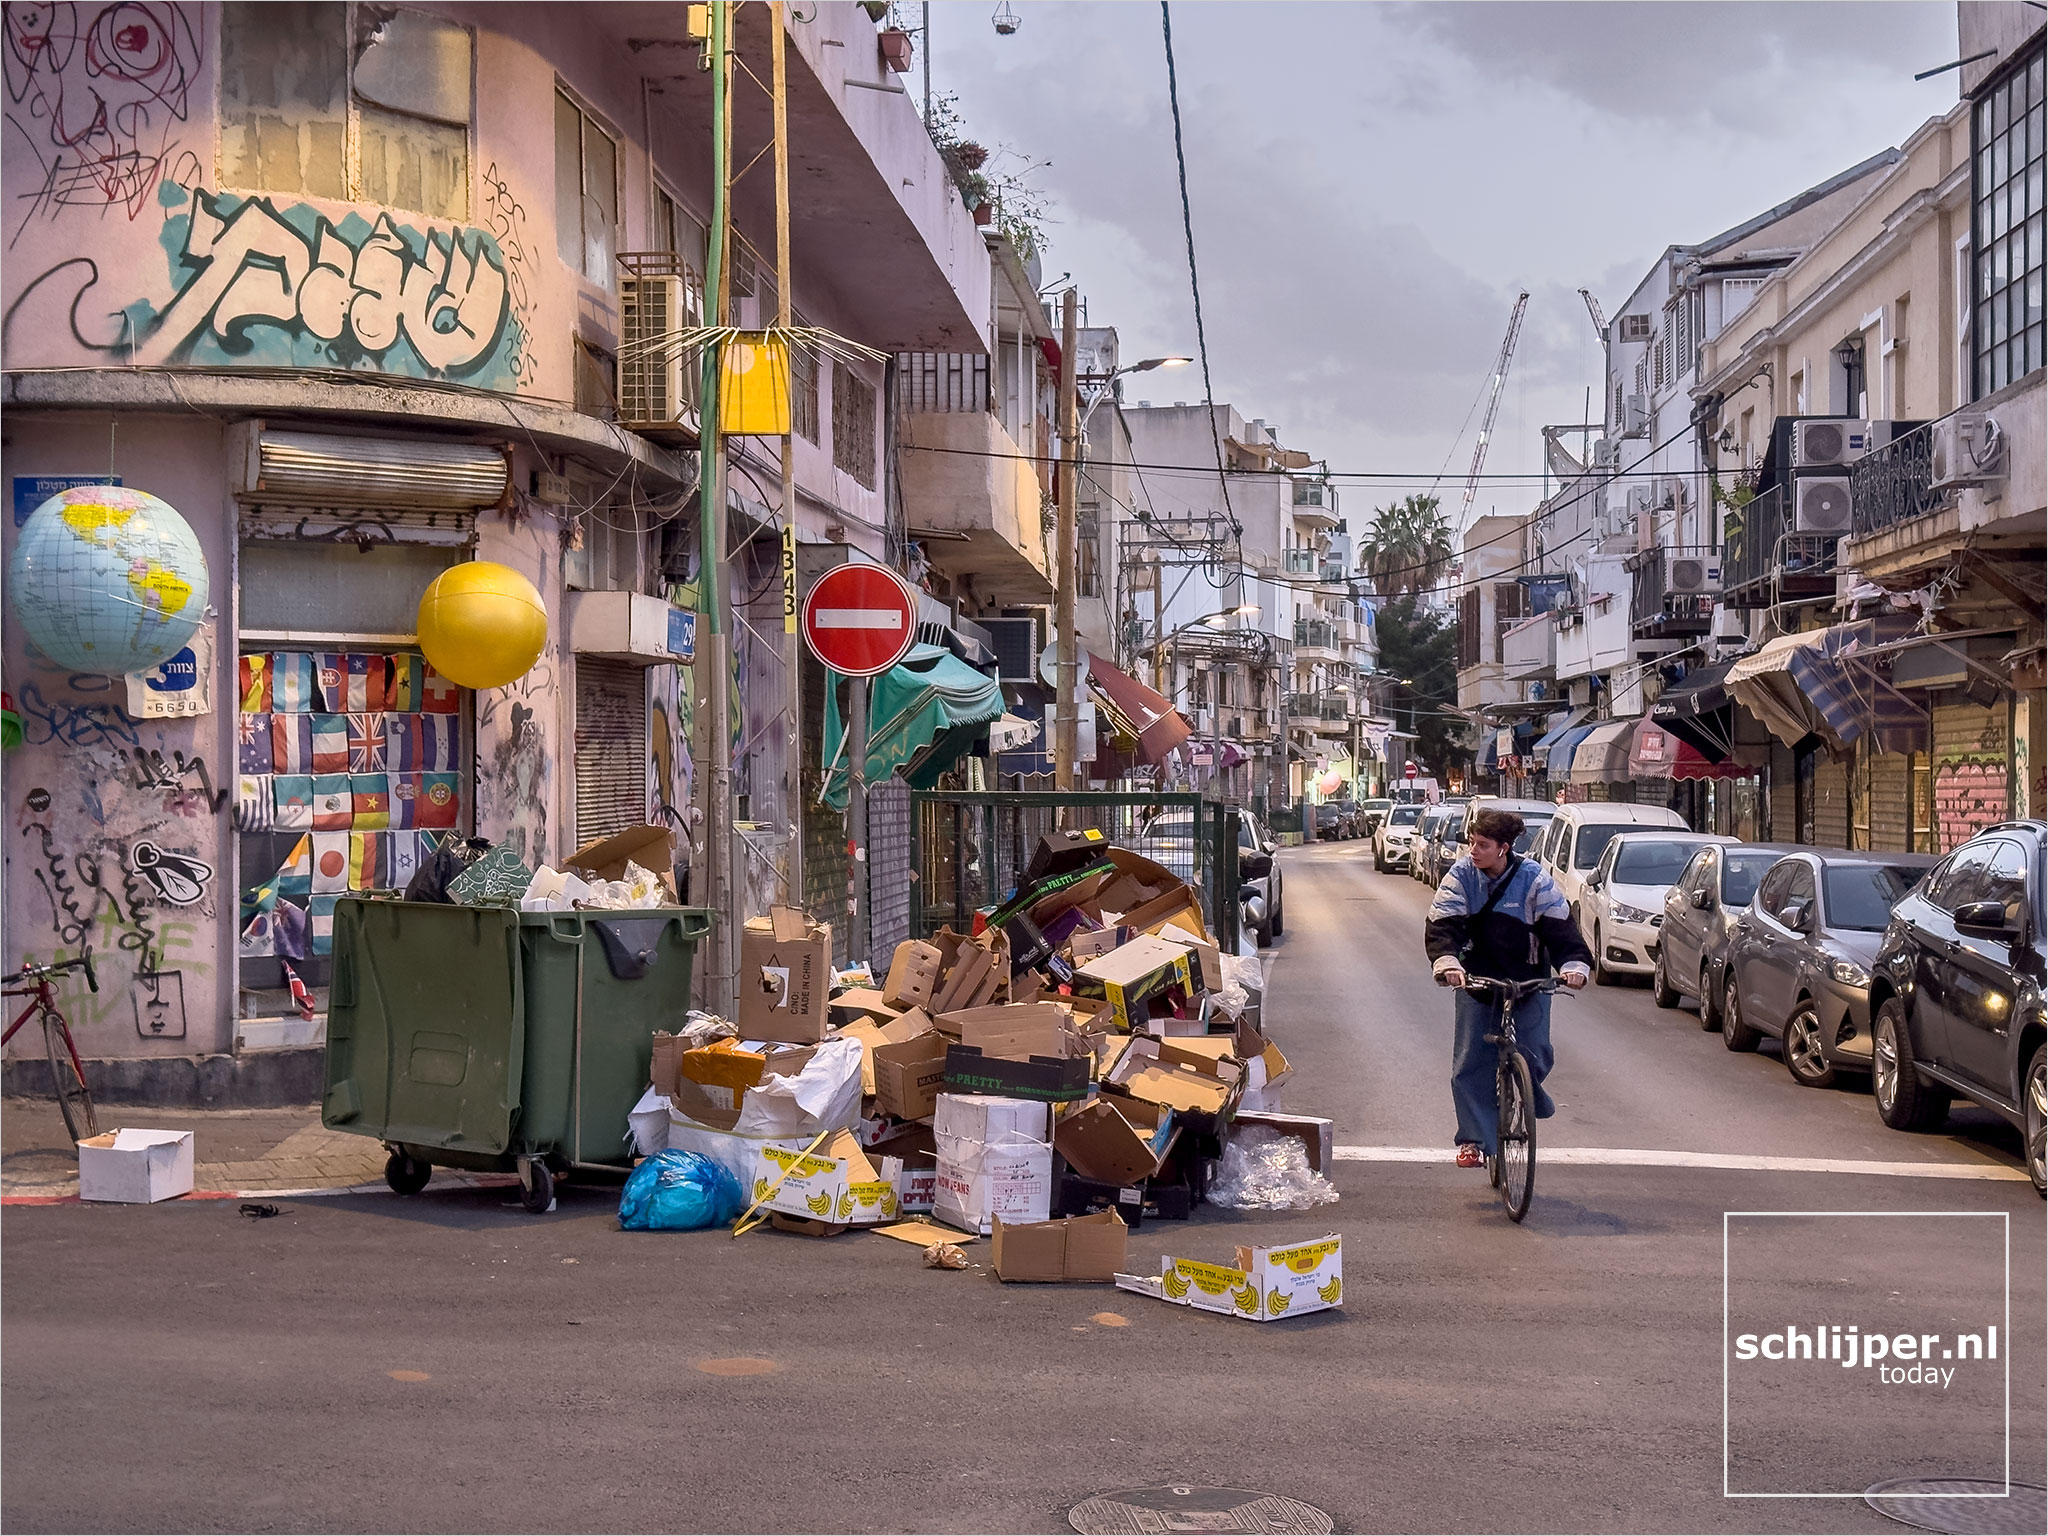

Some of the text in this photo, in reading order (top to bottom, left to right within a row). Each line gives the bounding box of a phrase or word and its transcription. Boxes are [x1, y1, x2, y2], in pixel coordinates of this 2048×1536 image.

[782, 526, 796, 616] 1343
[682, 622, 694, 646] 29
[167, 662, 195, 674] צוות
[1046, 873, 1075, 890] PRETTY
[801, 953, 812, 1015] MADE IN CHINA
[956, 1072, 1004, 1090] PRETTY
